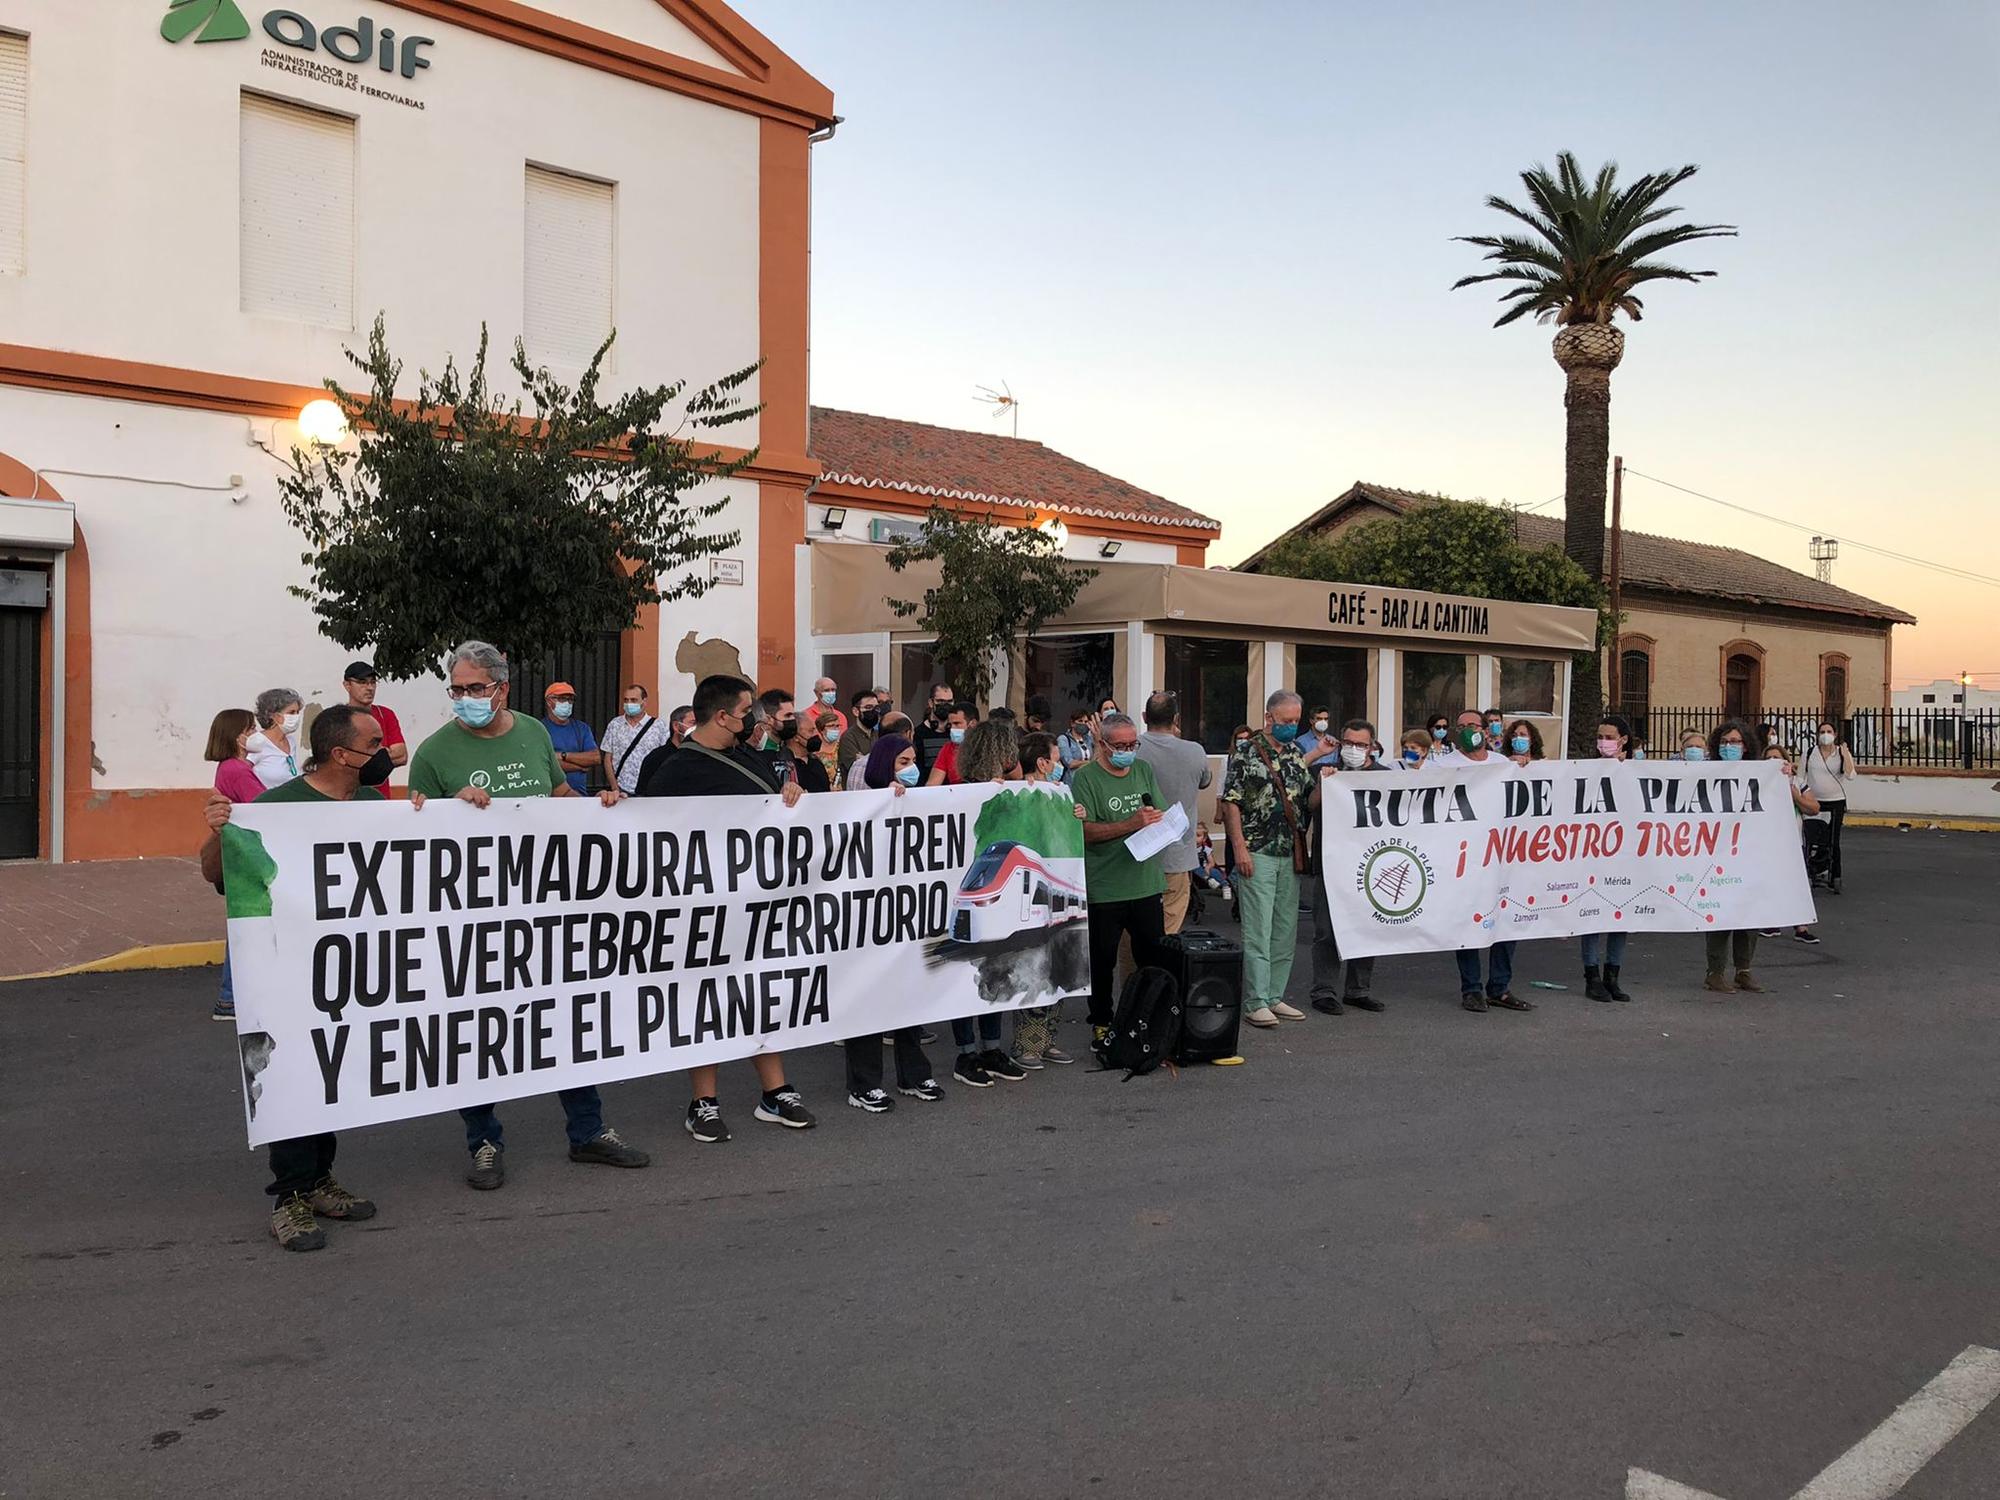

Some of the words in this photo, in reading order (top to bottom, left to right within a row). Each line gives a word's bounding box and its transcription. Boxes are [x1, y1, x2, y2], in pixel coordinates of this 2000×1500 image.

[262, 9, 435, 79] adif
[261, 49, 343, 79] ADMINISTRADOR
[346, 72, 359, 83] DE
[261, 57, 357, 91] INFRAESTRUCTURAS
[360, 85, 425, 110] FERROVIARIAS
[1328, 591, 1366, 626] CAFÉ
[1381, 598, 1408, 629] BAR
[1411, 600, 1429, 631] LA
[1433, 602, 1489, 635] CANTINA
[497, 762, 526, 772] RUTA
[507, 772, 521, 780] DE
[491, 785, 505, 793] LA
[508, 779, 541, 789] PLATA
[1350, 784, 1478, 829] RUTA
[1500, 779, 1553, 818] DE
[1574, 776, 1618, 815] LA
[1637, 777, 1765, 815] PLATA
[313, 830, 714, 921] EXTREMADURA
[726, 826, 813, 892] POR
[823, 819, 873, 881] UN
[884, 813, 966, 875] TREN
[1356, 862, 1366, 893] TREN
[1362, 839, 1387, 860] RUTA
[1389, 837, 1403, 846] DE
[1405, 841, 1418, 854] LA
[1418, 852, 1435, 886] PLATA
[1546, 881, 1579, 891] Salamanca
[1604, 876, 1631, 886] Mérida
[1709, 875, 1743, 886] Algeciras
[1371, 906, 1423, 925] Movimiento
[1513, 912, 1539, 923] Zamora
[1579, 907, 1600, 918] Cáceres
[1634, 905, 1656, 915] Zafra
[311, 927, 426, 1022] QUE
[437, 907, 681, 998] VERTEBRE
[684, 905, 731, 969] EL
[744, 880, 949, 962] TERRITORIO
[310, 1025, 350, 1105] Y
[571, 990, 625, 1064] EL
[637, 964, 830, 1053] PLANETA
